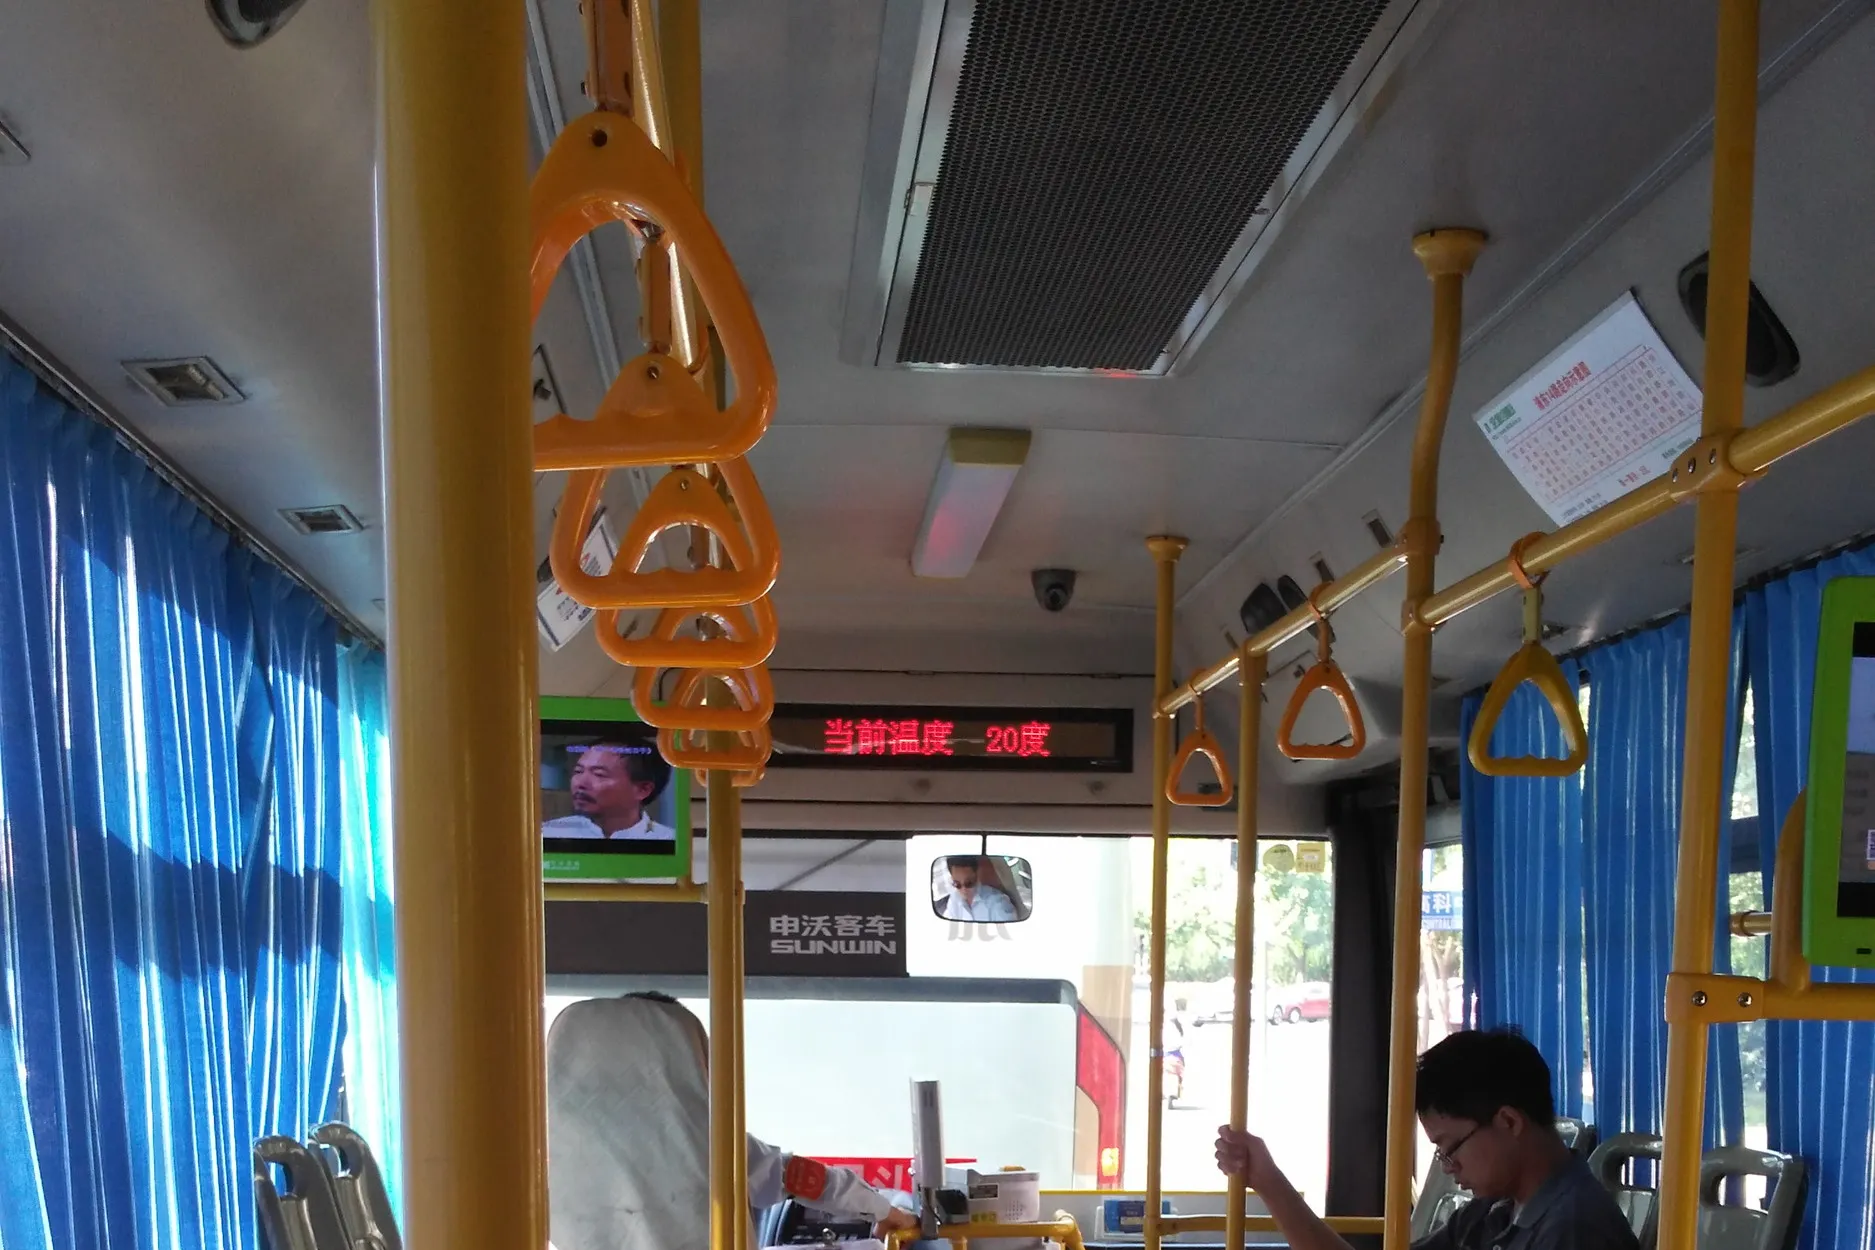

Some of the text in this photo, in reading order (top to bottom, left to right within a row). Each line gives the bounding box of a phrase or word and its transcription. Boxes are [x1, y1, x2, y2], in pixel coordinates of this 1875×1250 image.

[824, 719, 1051, 756] 当前温度 20度
[770, 915, 896, 936] 申沃客车
[770, 940, 896, 954] SUNWIN
